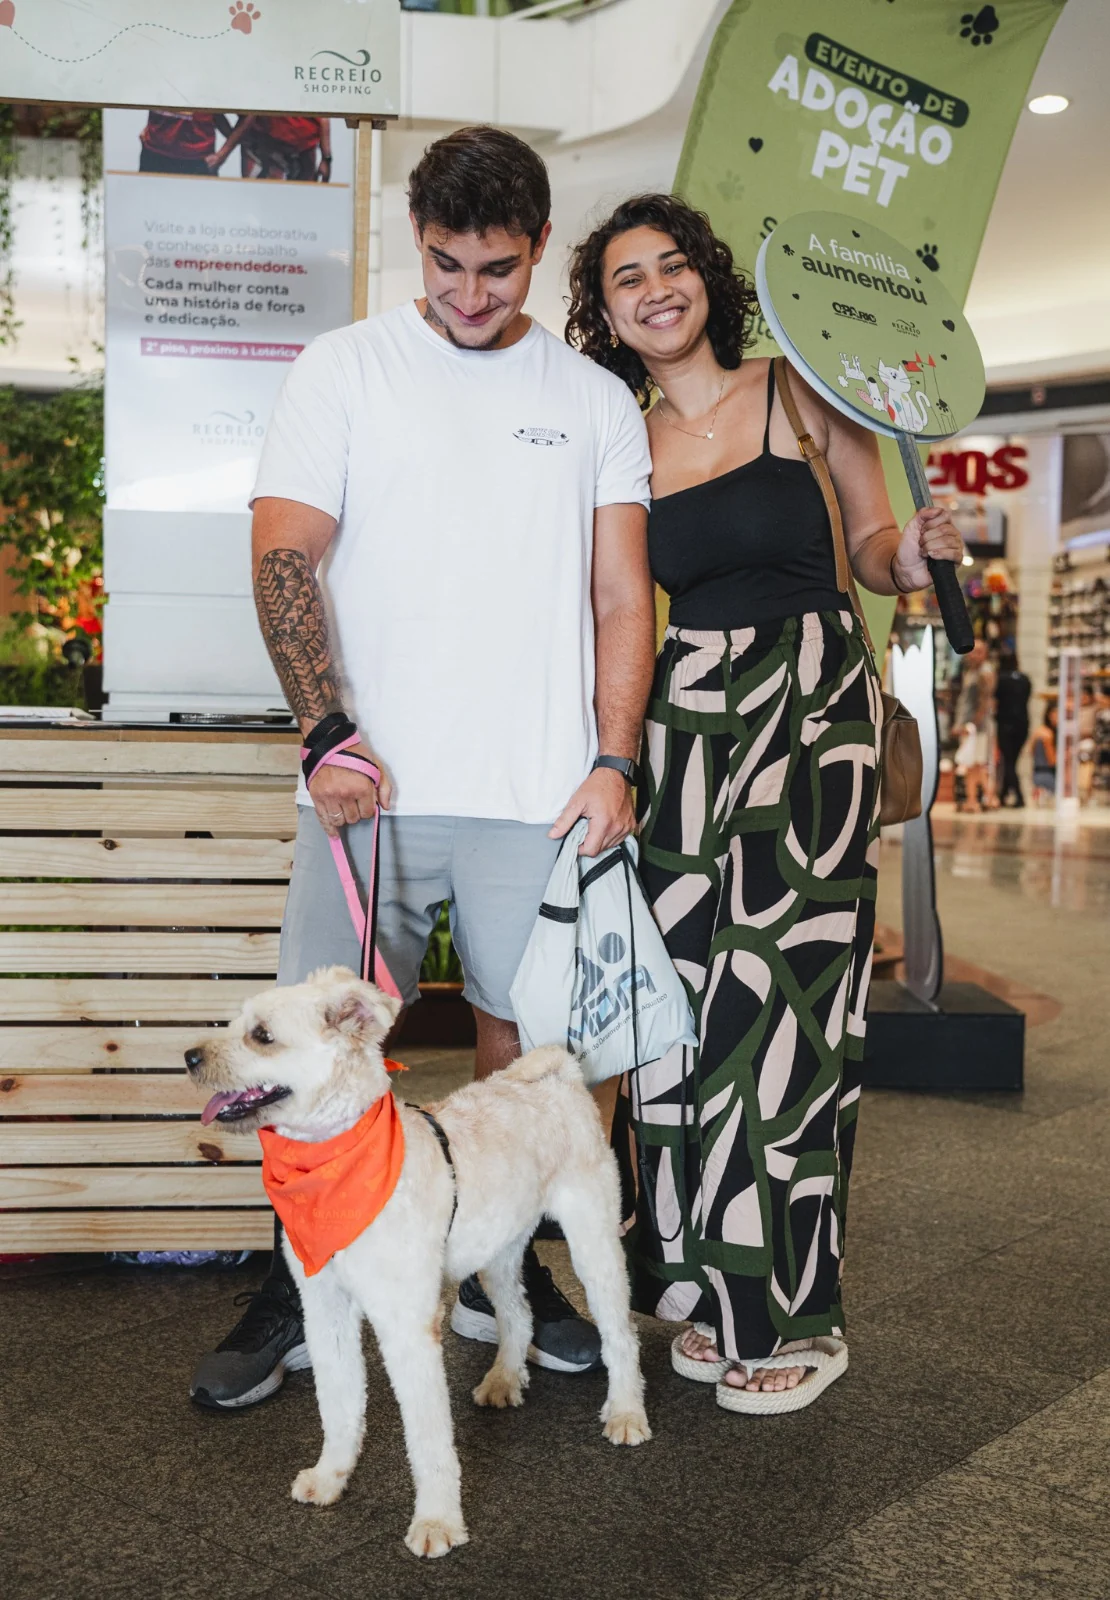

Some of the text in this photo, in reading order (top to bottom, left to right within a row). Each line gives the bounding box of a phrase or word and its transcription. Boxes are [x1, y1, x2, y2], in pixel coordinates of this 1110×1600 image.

[294, 66, 382, 83] RECREIO
[815, 40, 957, 120] EVENTO DE
[303, 83, 372, 95] SHOPPING
[767, 54, 953, 166] ADOÇÃO
[811, 129, 910, 208] PET
[144, 220, 318, 241] Visite a loja colaborativa
[144, 240, 299, 257] e conheça o trabalho
[808, 233, 826, 256] A
[145, 256, 308, 275] das empreendedoras.
[145, 277, 289, 296] Cada mulher conta
[801, 256, 928, 306] aumentou
[145, 296, 306, 317] uma história de força
[144, 312, 241, 330] e dedicação.
[190, 344, 239, 356] próximo
